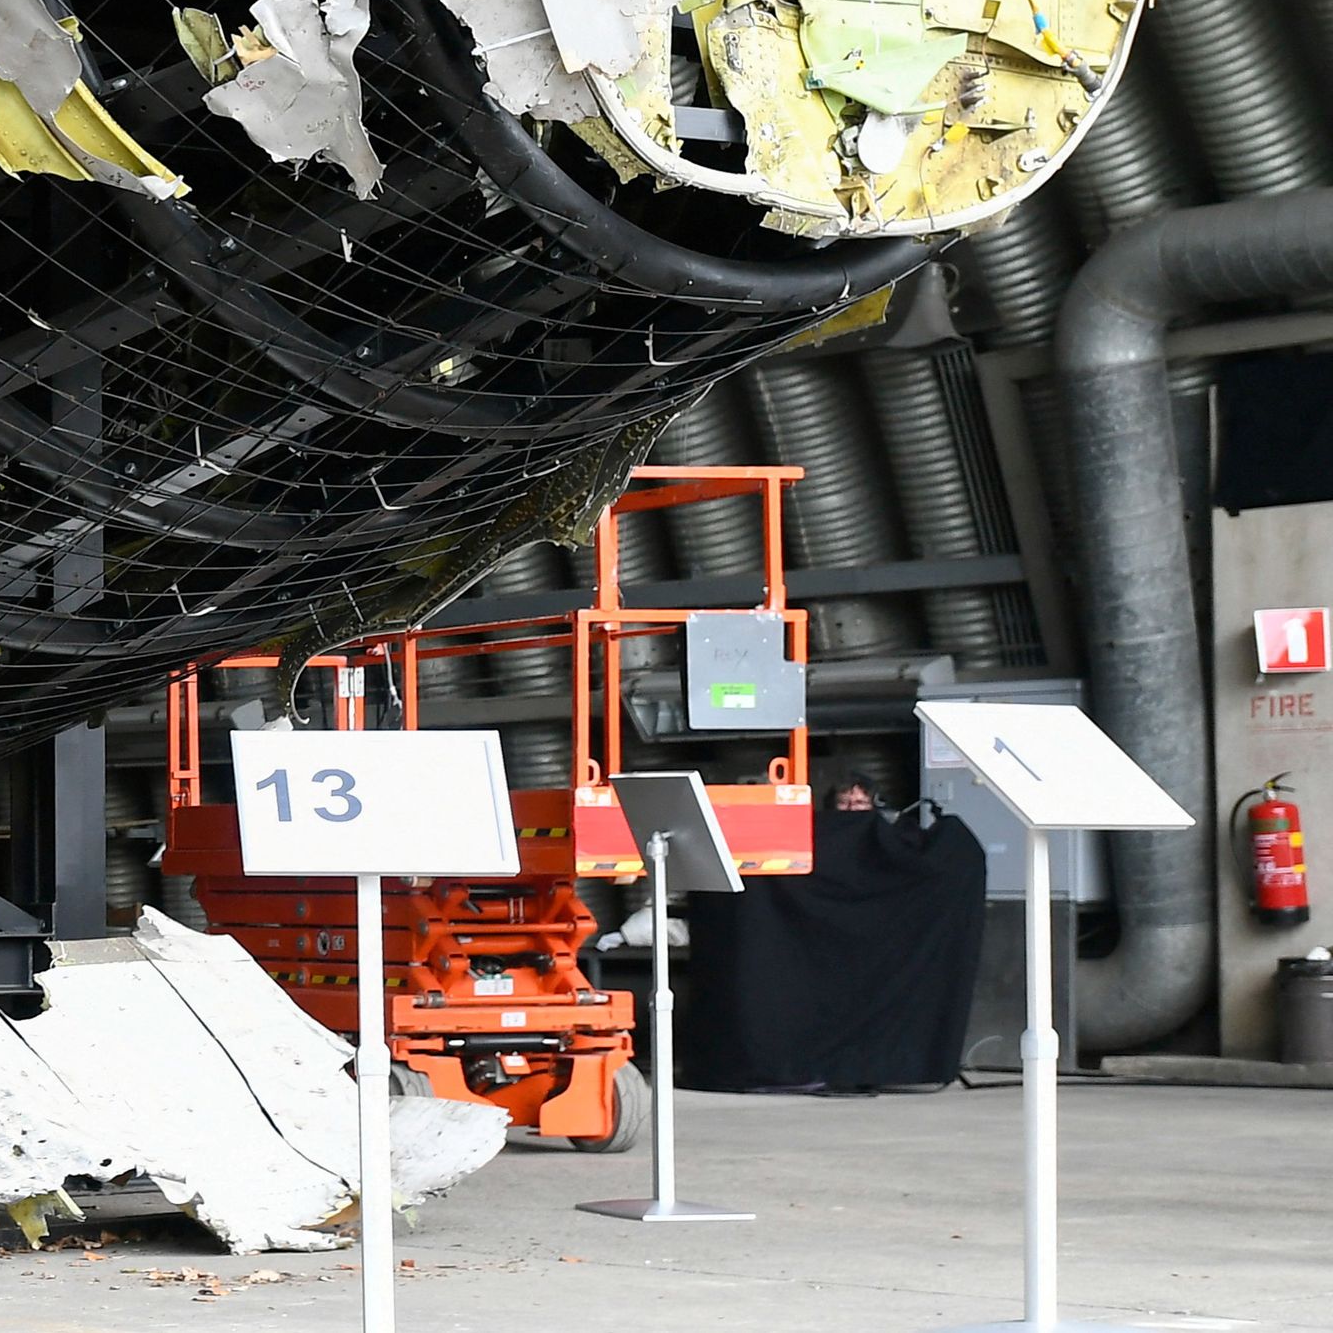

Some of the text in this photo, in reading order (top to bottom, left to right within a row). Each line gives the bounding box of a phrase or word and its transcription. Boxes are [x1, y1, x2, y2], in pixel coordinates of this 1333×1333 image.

[1250, 693, 1314, 718] FIRE
[993, 737, 1042, 781] 1
[256, 769, 362, 822] 13
